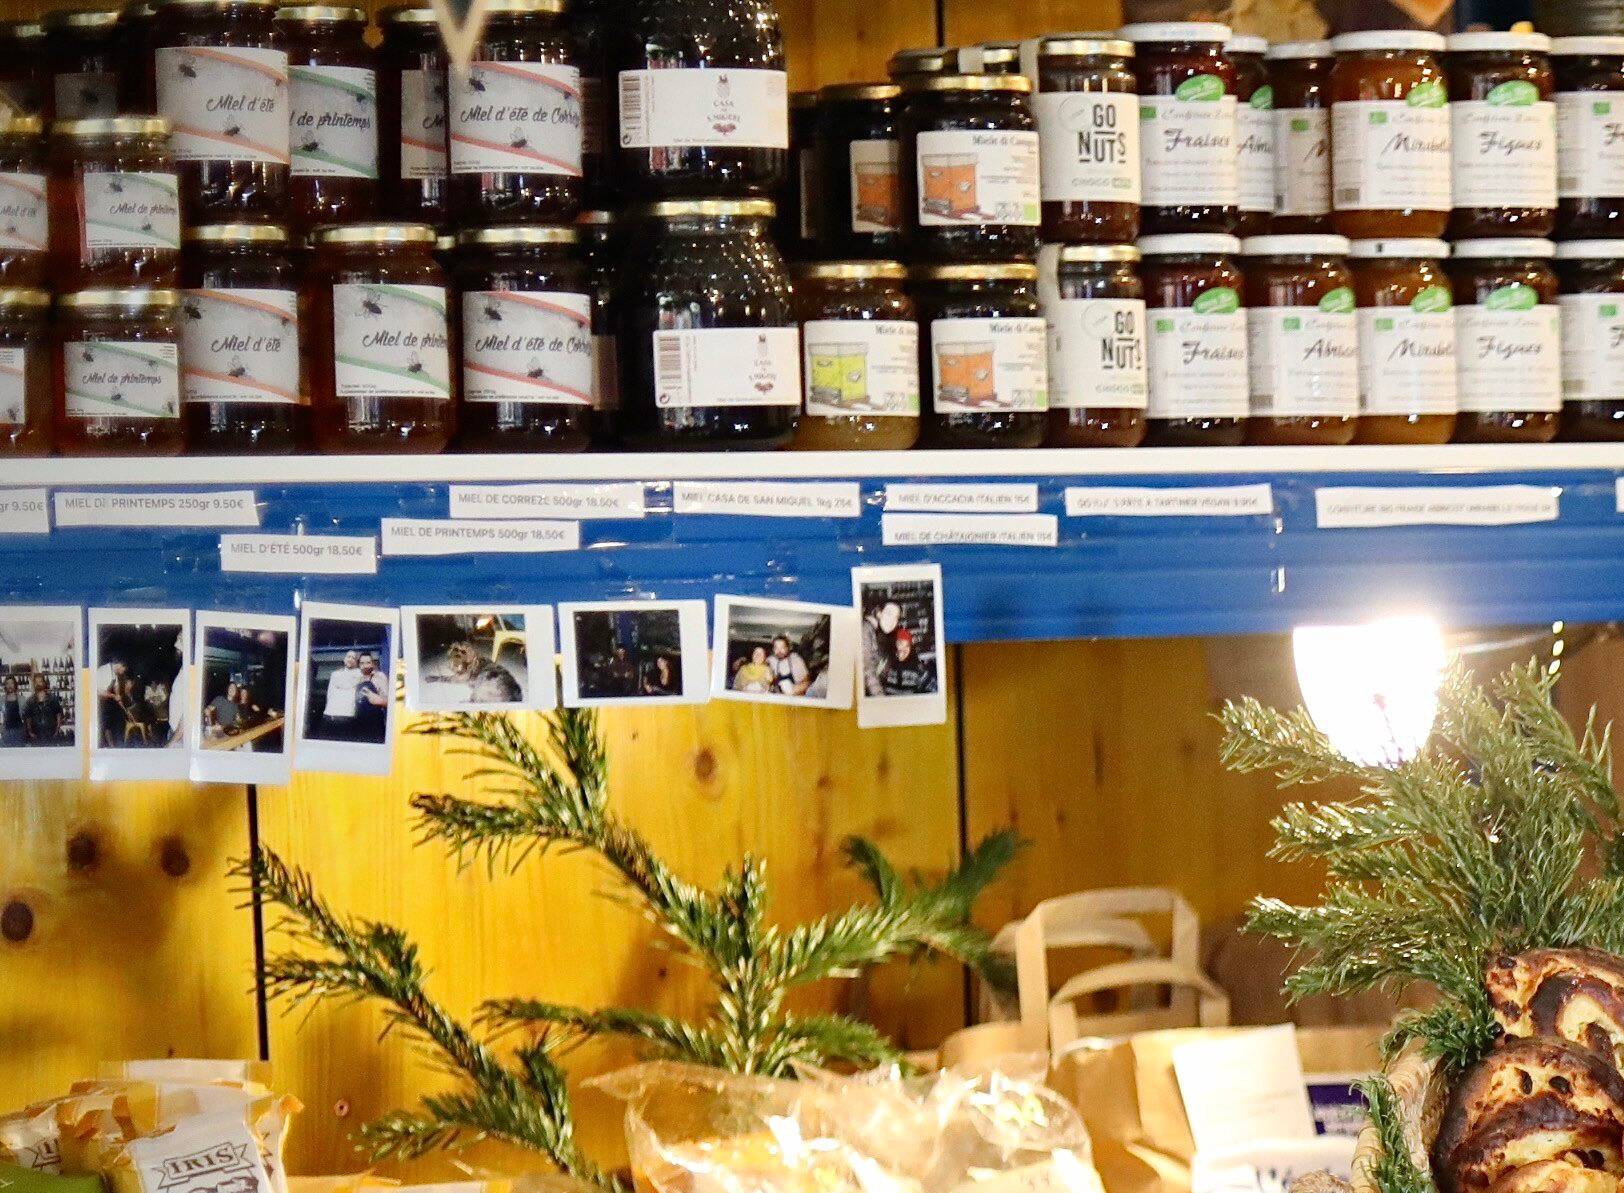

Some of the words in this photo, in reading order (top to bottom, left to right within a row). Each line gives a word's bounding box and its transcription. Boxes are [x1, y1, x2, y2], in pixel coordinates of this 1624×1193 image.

[206, 95, 246, 113] Miel
[460, 106, 494, 124] Miel
[1093, 104, 1117, 128] GO
[1078, 131, 1127, 163] NUTS
[1114, 311, 1136, 335] GO
[211, 335, 251, 352] Miel
[362, 331, 402, 348] Miel
[475, 336, 509, 353] Miel
[12, 500, 44, 513] 9.50€
[65, 498, 92, 509] MIEL
[111, 499, 176, 509] PRINTEMPS
[178, 499, 210, 511] 250gr
[212, 498, 244, 509] 9.50€
[459, 493, 483, 504] MIEL
[485, 494, 500, 504] DE
[391, 526, 417, 537] MIEL
[418, 527, 432, 538] DE
[435, 527, 496, 539] PRINTEMPS
[230, 543, 256, 554] MIEL
[292, 544, 324, 556] 500gr
[169, 1147, 236, 1175] IRIS
